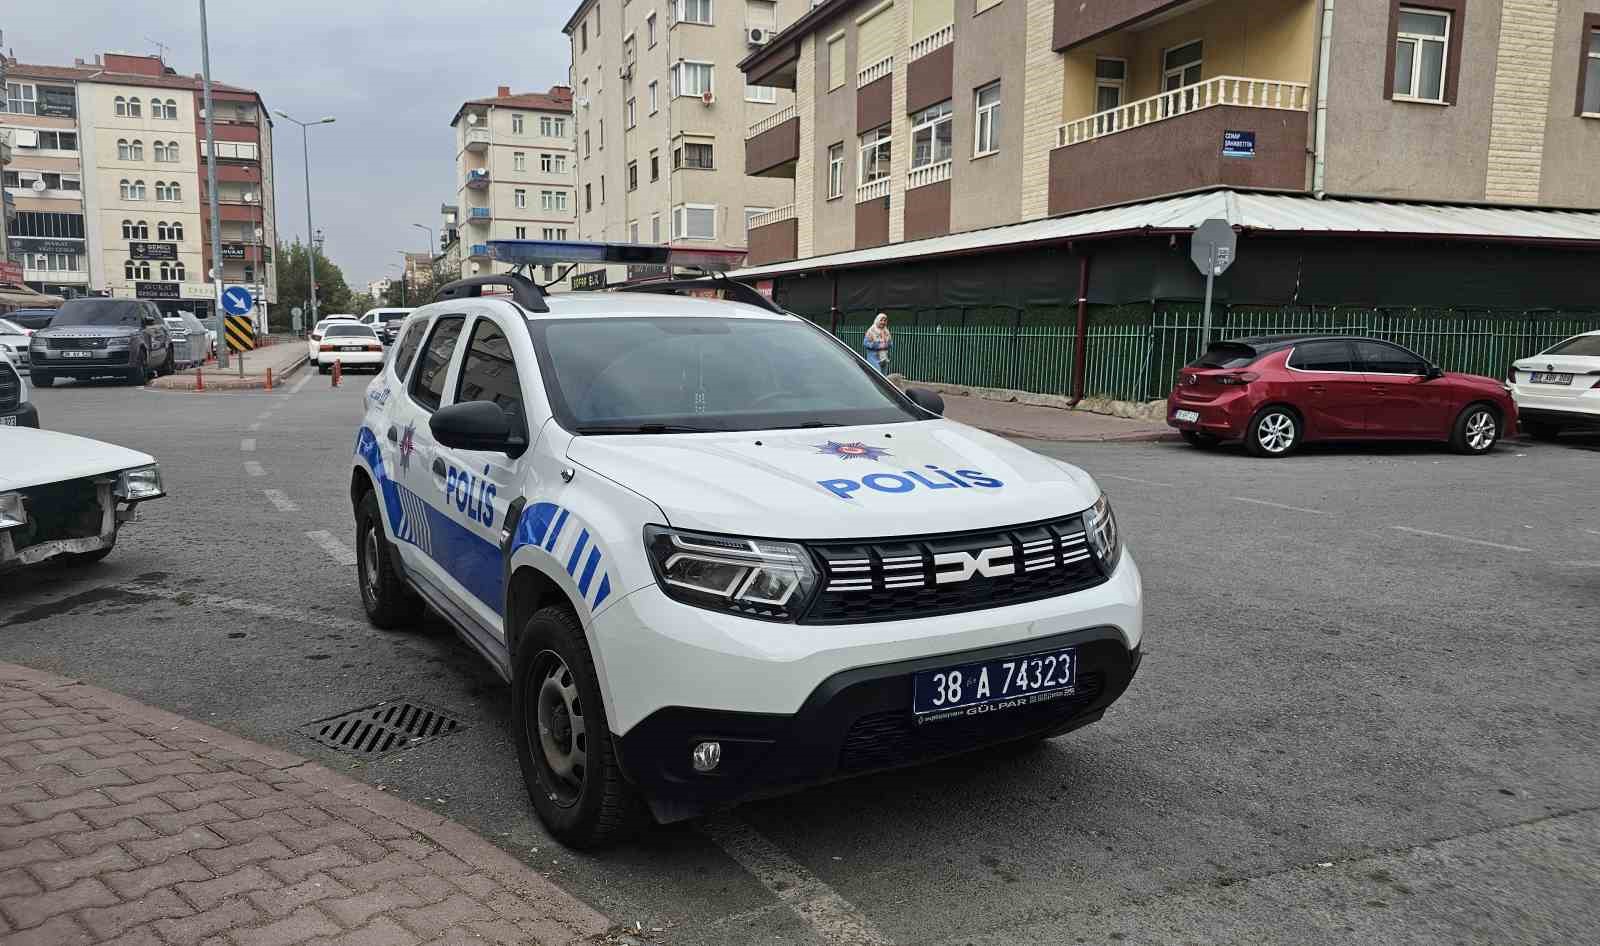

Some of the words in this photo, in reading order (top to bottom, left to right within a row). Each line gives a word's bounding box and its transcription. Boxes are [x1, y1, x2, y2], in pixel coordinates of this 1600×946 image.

[445, 463, 498, 528] POLİS
[816, 464, 1005, 499] POLİS
[932, 670, 963, 706] 38
[976, 666, 991, 699] A
[1002, 653, 1071, 694] 74323
[966, 698, 1027, 716] GÜLPAR
